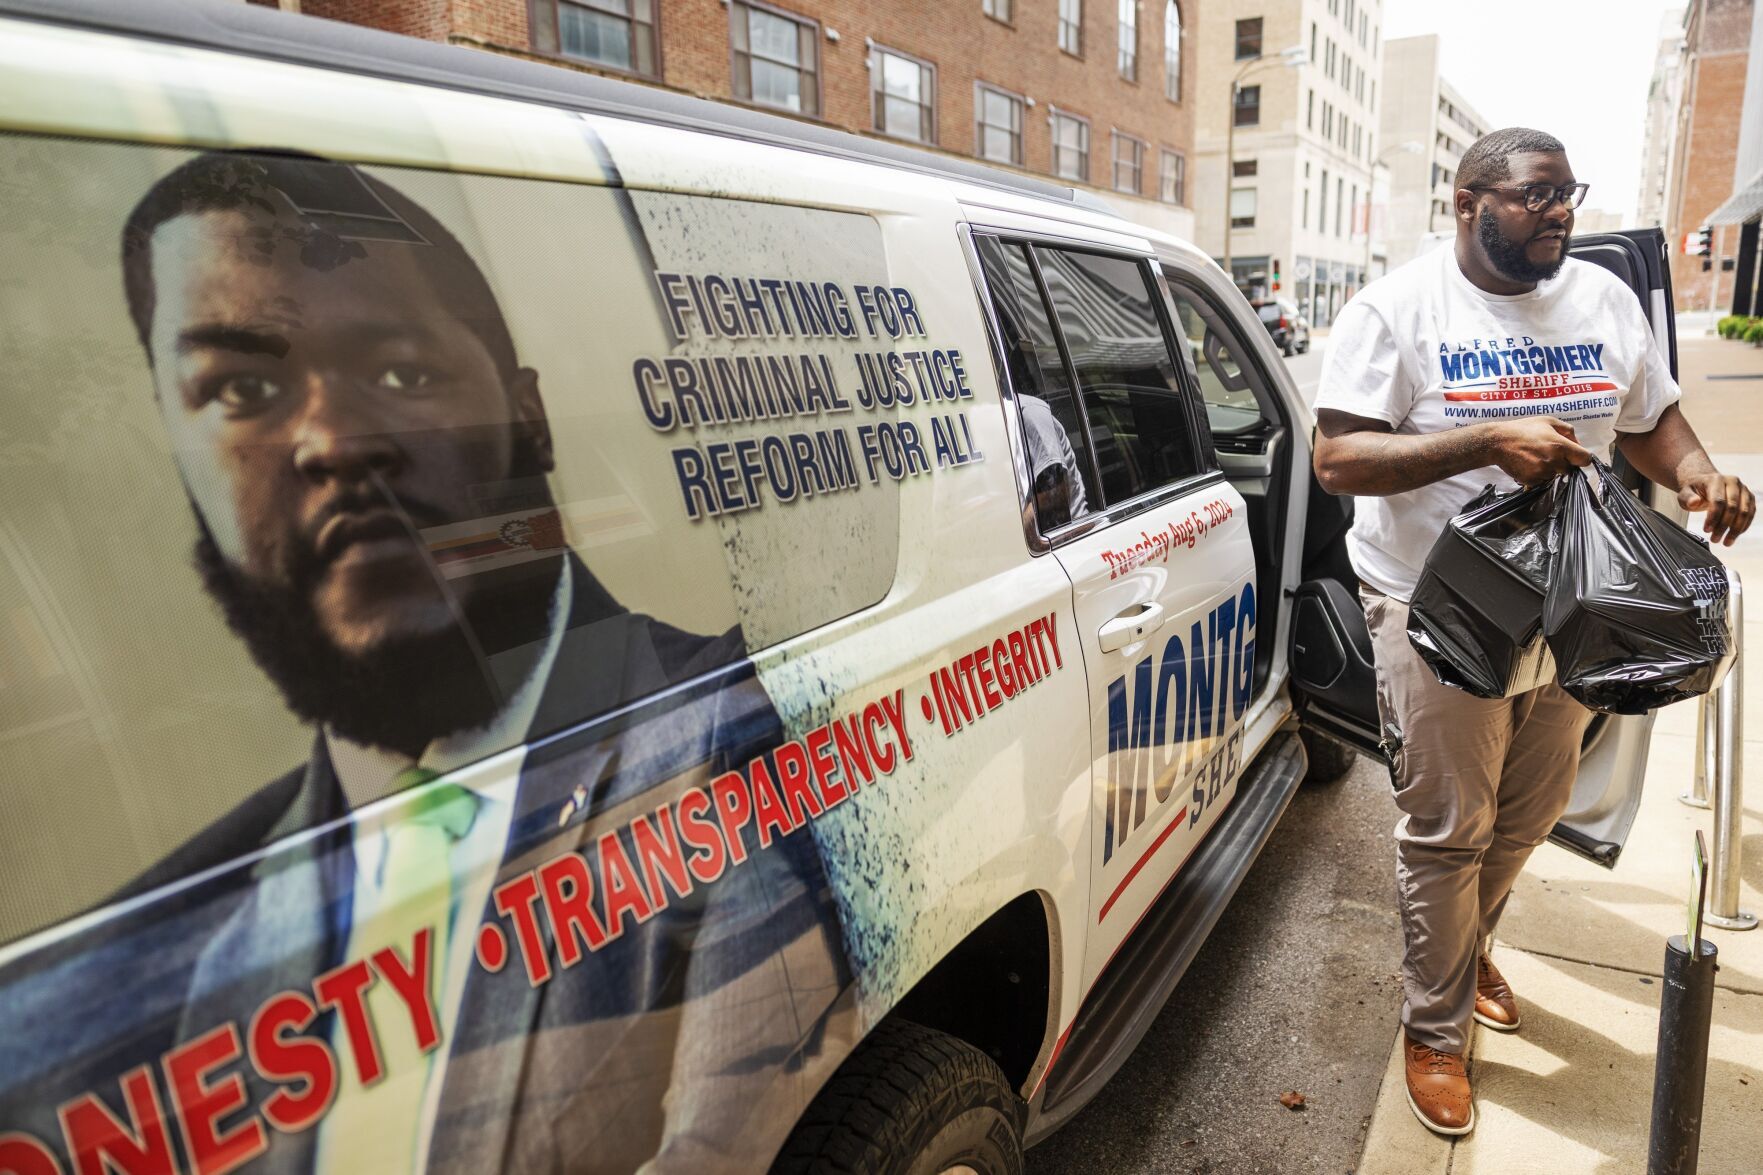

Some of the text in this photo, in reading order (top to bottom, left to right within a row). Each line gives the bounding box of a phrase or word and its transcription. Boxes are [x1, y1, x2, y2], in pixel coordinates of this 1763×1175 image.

[654, 269, 927, 340] FIGHTING FOR
[1440, 336, 1534, 354] ALFRED
[632, 348, 974, 432] CRIMINAL JUSTICE
[1440, 343, 1604, 382] MONTGOMERY
[1480, 383, 1593, 401] CITY OF ST. LOUIS
[1499, 373, 1569, 390] SHERIFF
[671, 412, 984, 522] REFORM FOR ALL
[1101, 498, 1233, 580] Tuesday Aug 6, 2024
[1679, 565, 1729, 586] THA
[929, 612, 1065, 739] INTEGRITY
[1103, 582, 1257, 868] MONTG
[1189, 727, 1245, 831] SHE
[493, 689, 914, 988] TRANSPARENCY
